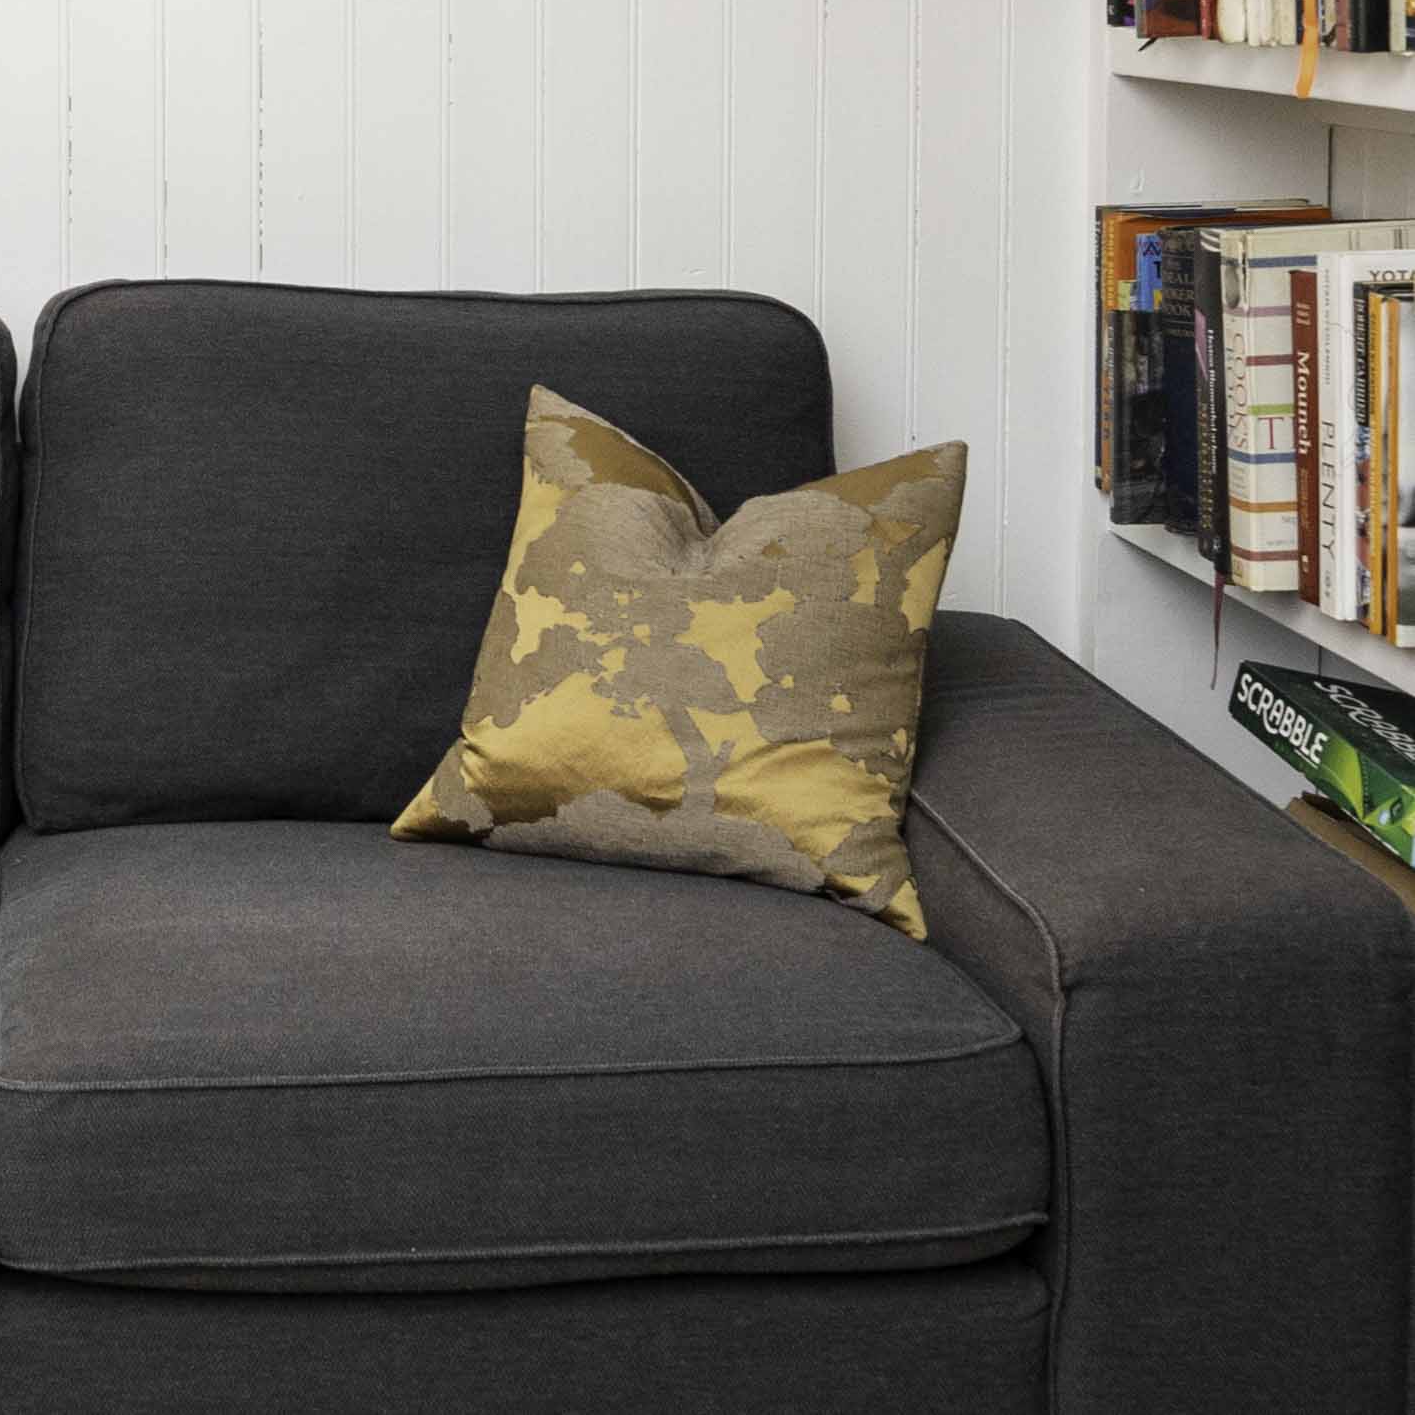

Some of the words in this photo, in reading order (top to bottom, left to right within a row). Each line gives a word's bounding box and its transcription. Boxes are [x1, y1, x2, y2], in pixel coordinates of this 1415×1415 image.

[1207, 329, 1215, 366] Heston
[1233, 333, 1248, 449] COOK'S
[1354, 355, 1367, 424] CARRIER
[1208, 369, 1218, 431] Blumenthal
[1297, 350, 1311, 455] Mouneh
[1322, 421, 1336, 561] PLENTY
[1237, 673, 1329, 764] SCRABBLE
